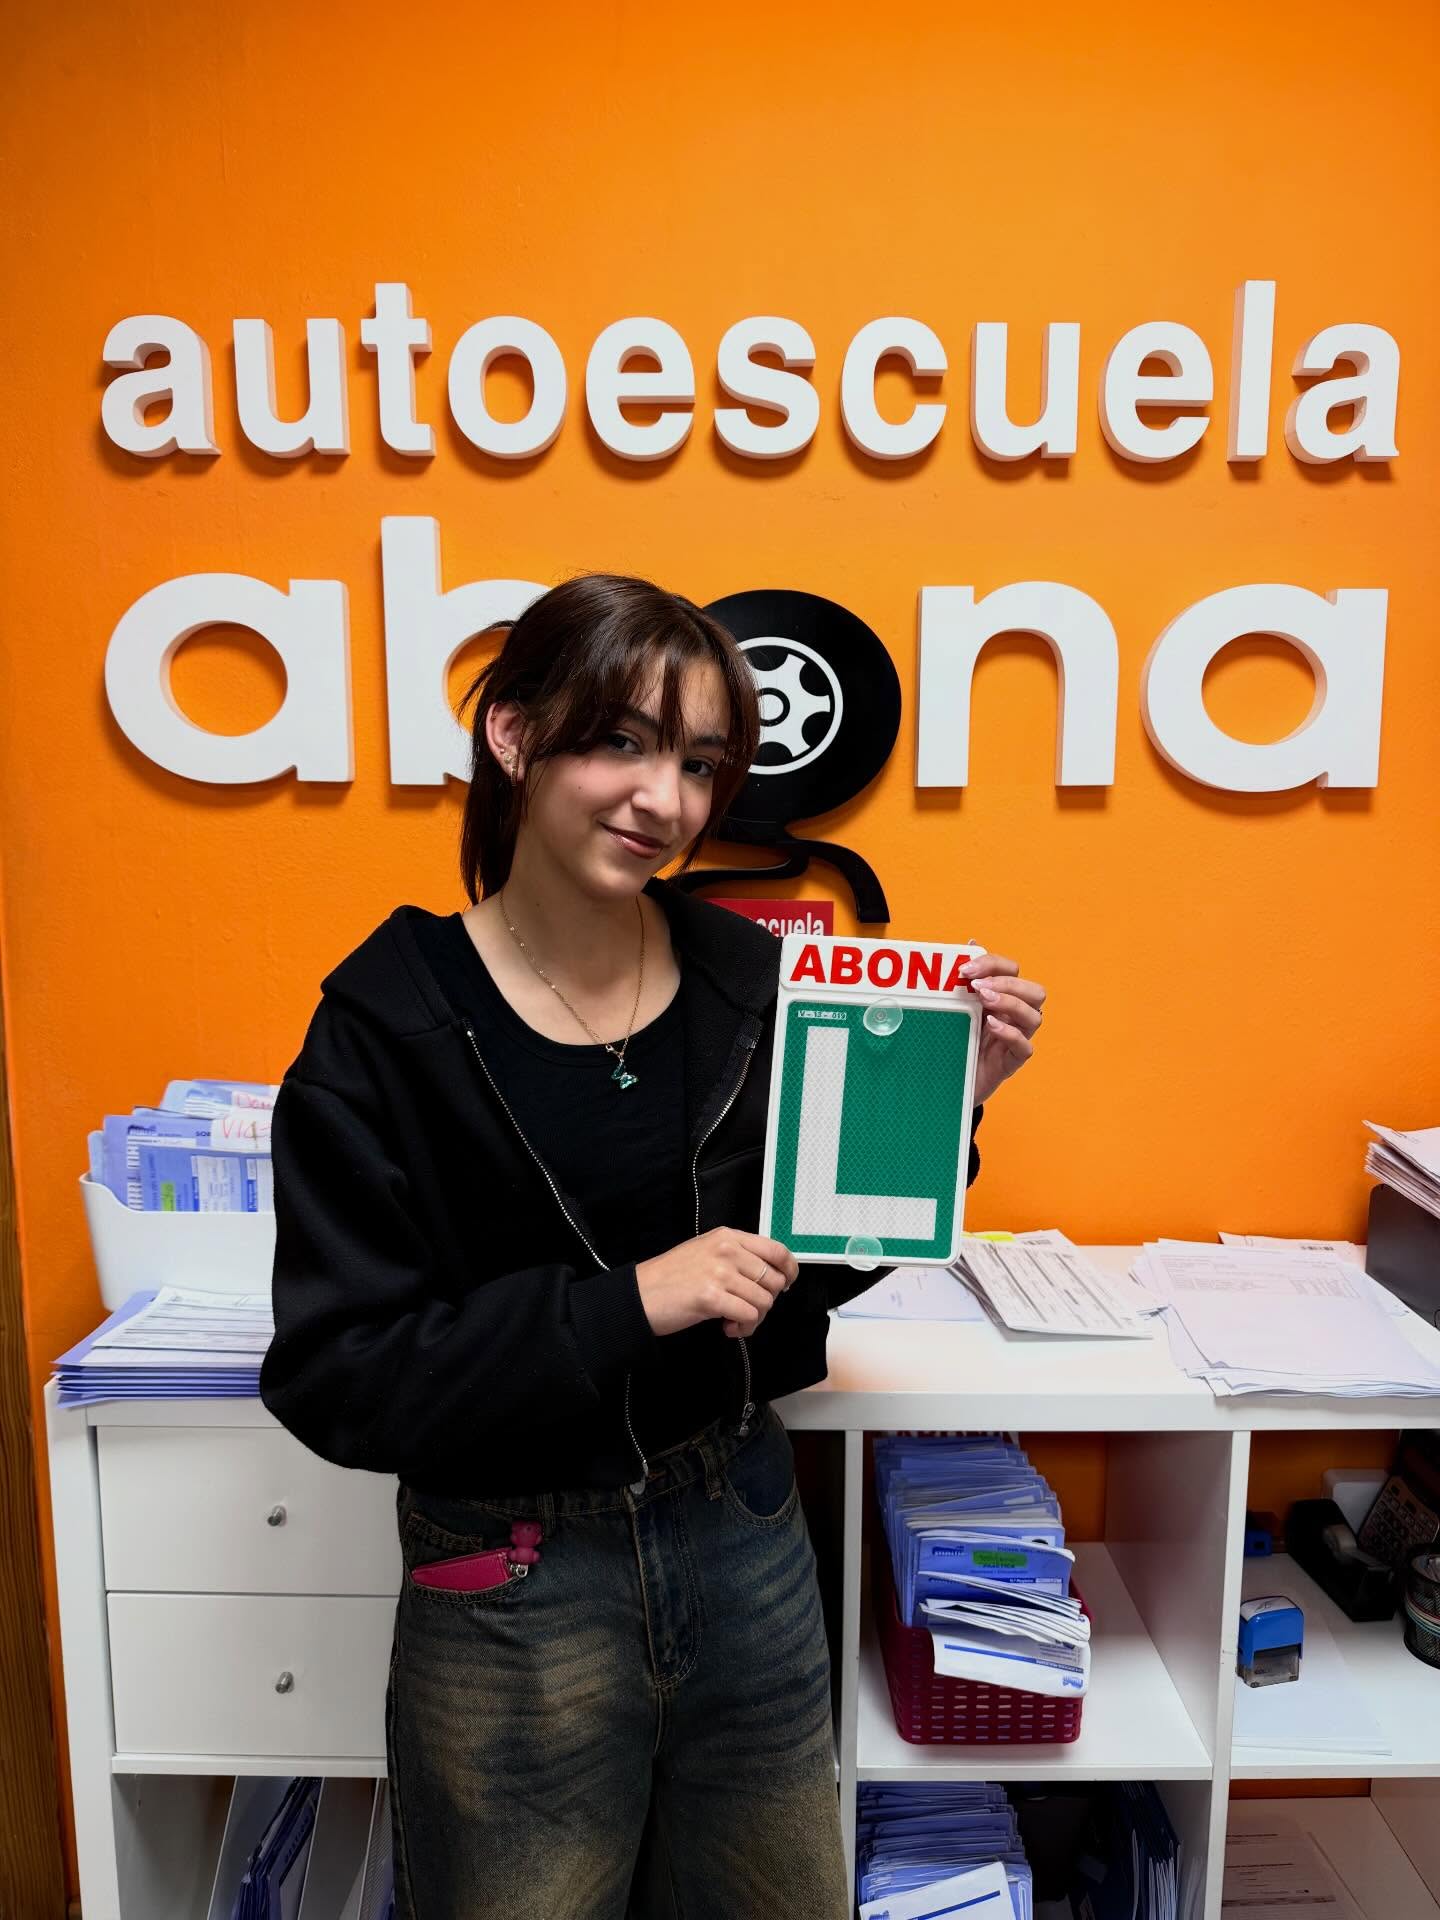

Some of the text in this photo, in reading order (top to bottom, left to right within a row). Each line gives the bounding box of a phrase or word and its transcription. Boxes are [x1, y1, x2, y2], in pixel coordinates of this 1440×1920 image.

[102, 280, 1400, 463] autoescuela
[790, 943, 977, 994] ABONA
[791, 1025, 938, 1241] L
